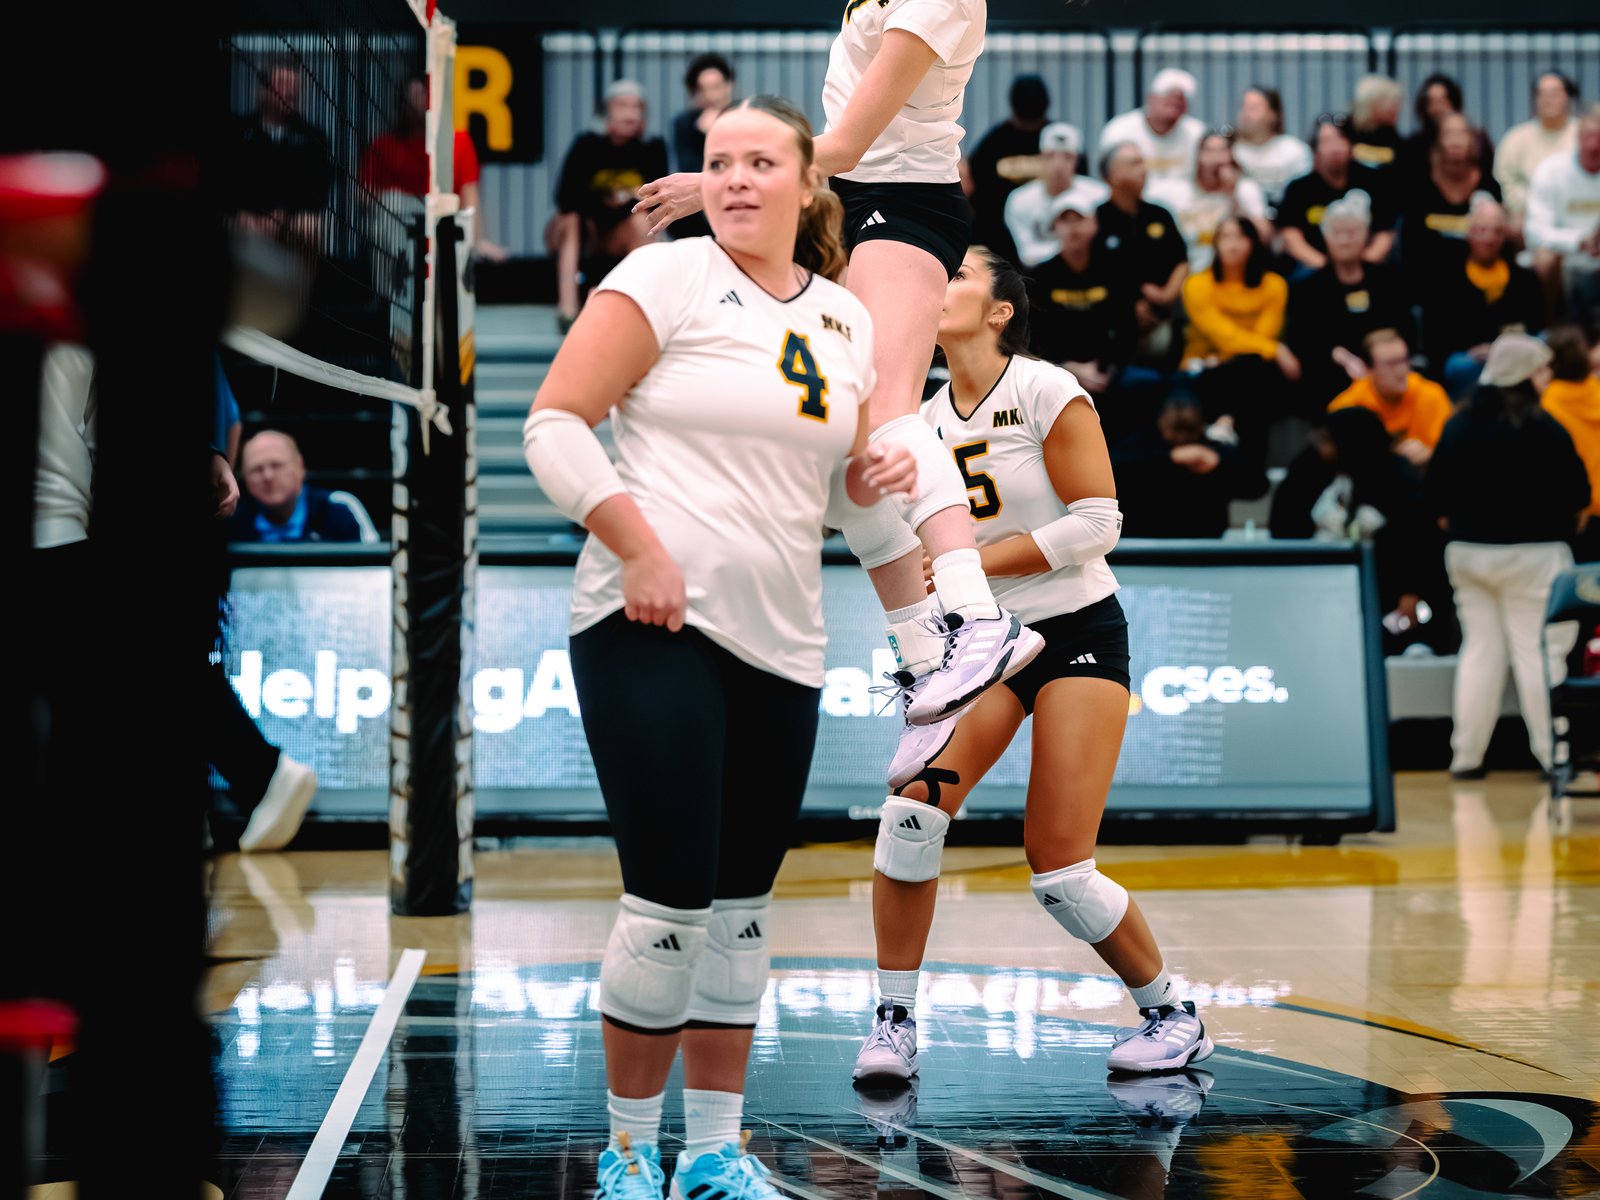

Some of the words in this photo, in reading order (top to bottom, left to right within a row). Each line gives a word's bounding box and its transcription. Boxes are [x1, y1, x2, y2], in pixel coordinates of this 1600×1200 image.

[453, 45, 513, 151] R
[777, 328, 829, 424] 4
[993, 408, 1024, 428] MK
[952, 440, 1003, 522] 5
